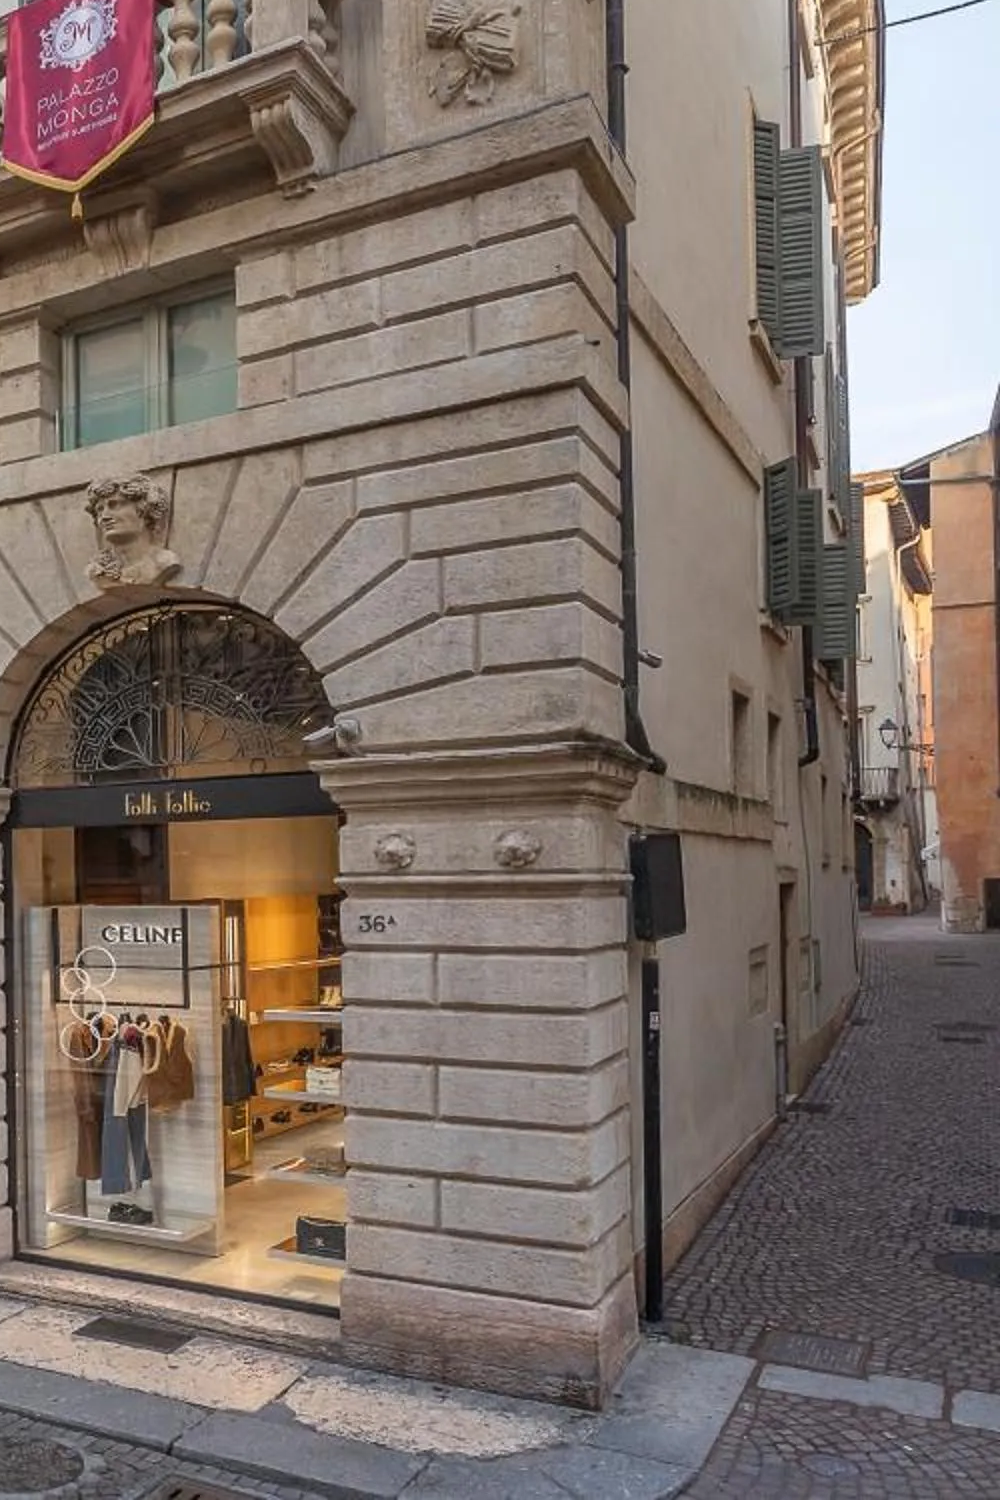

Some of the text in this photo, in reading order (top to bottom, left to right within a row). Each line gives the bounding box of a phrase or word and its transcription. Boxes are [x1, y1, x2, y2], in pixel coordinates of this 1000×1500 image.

[37, 67, 119, 114] PALAZZO
[37, 92, 119, 138] MONGA
[101, 925, 182, 943] CELINE
